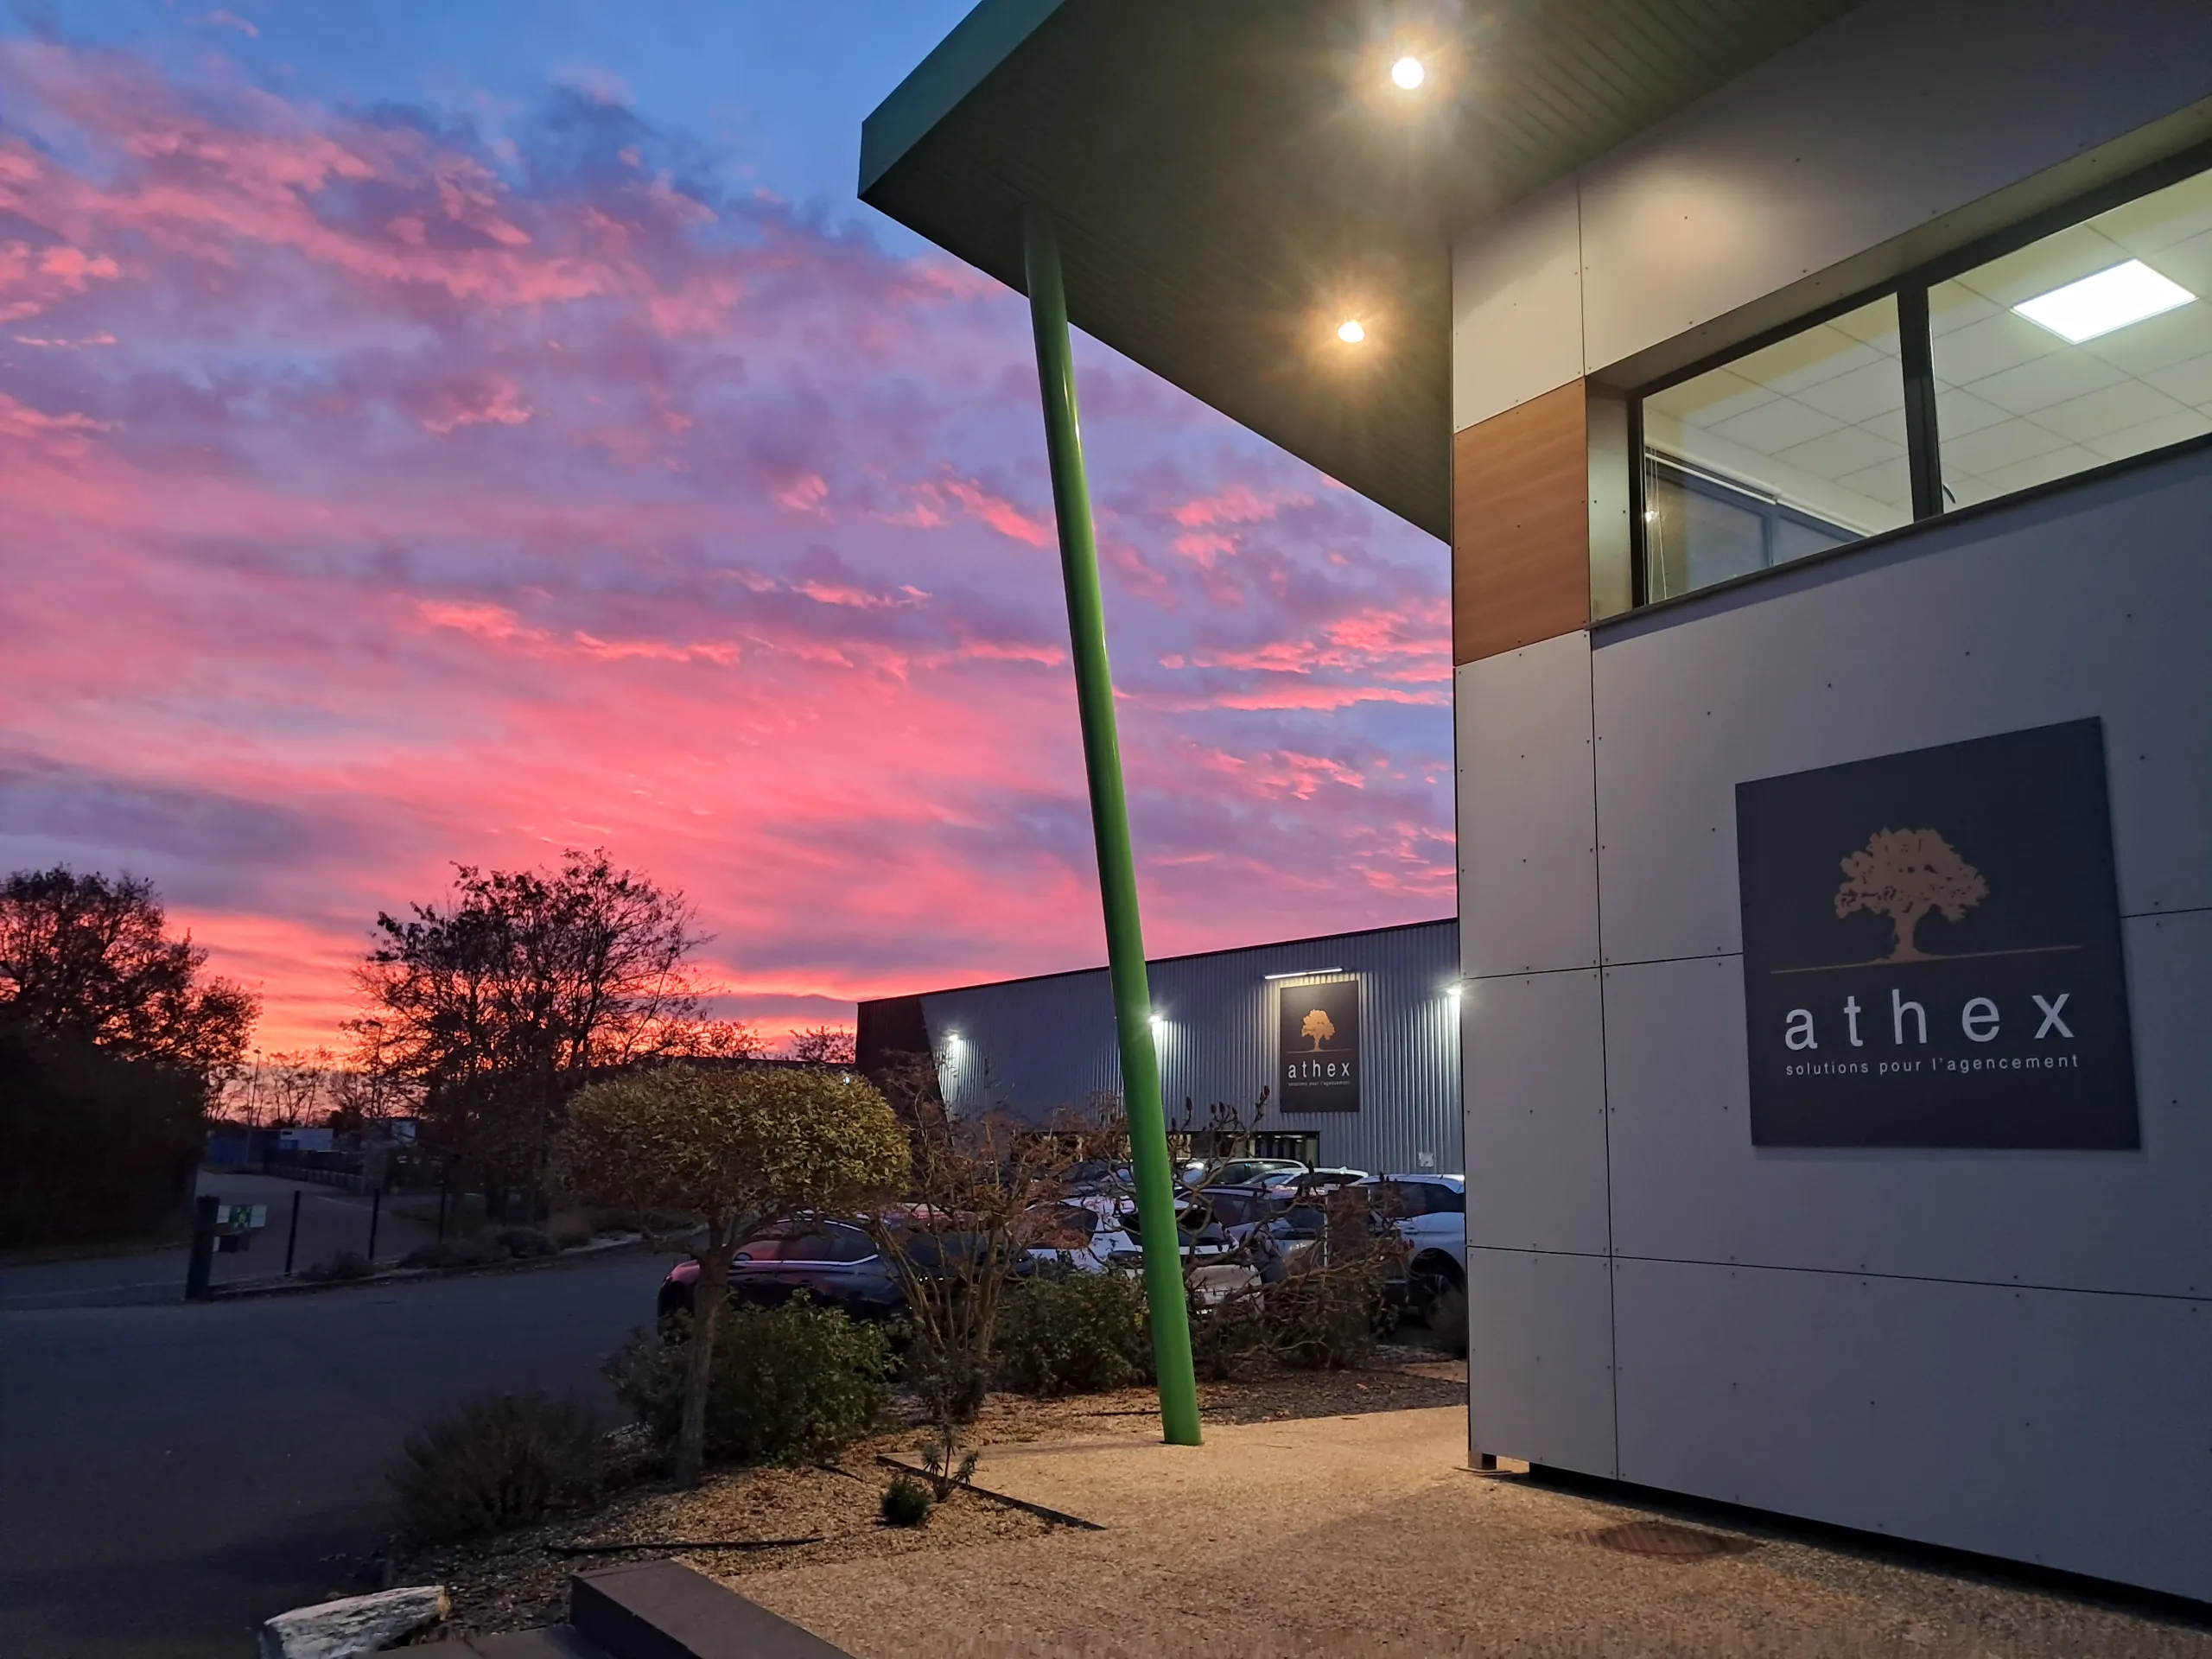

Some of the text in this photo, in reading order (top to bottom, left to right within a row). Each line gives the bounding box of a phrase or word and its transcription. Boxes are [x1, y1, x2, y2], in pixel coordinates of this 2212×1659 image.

[1784, 988, 2075, 1051] athex
[1287, 1059, 1350, 1078] athex
[1786, 1054, 2078, 1076] solutions pour l'agencement
